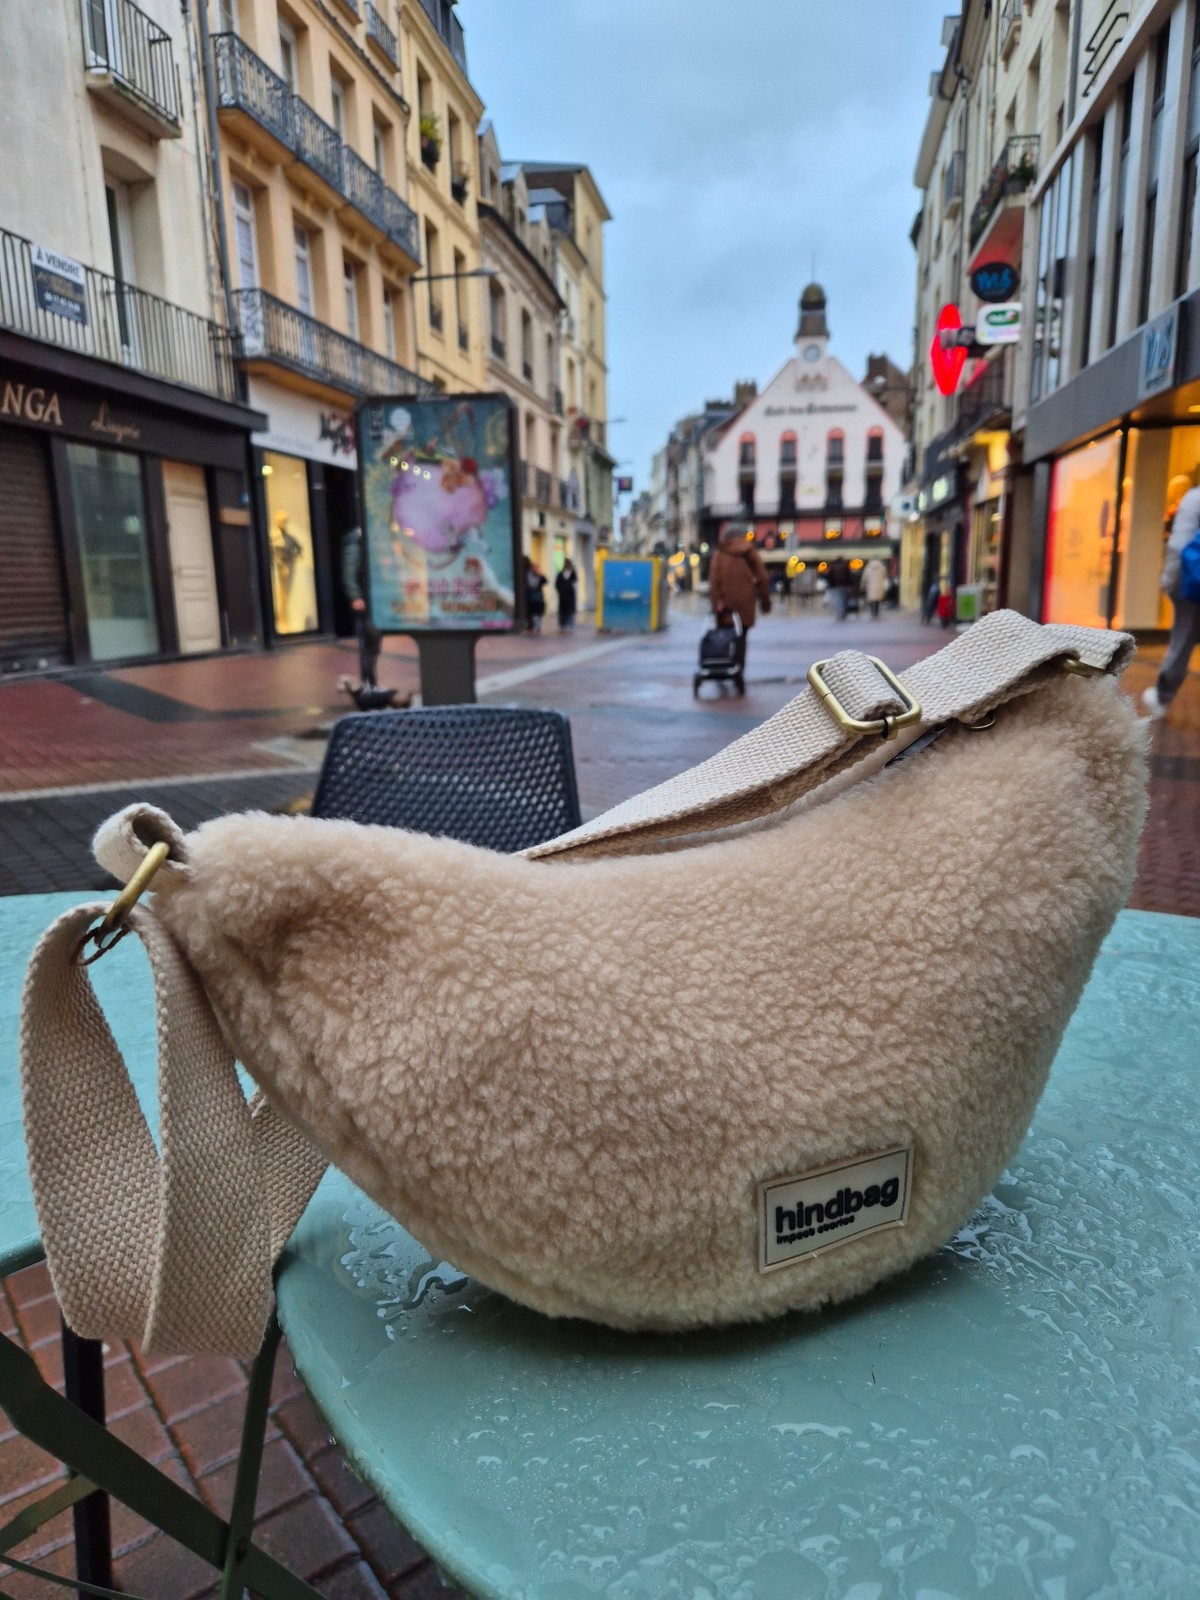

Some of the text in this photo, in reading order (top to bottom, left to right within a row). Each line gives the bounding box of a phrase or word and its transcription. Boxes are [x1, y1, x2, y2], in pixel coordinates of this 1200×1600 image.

[46, 251, 80, 277] VENDRE
[1, 381, 63, 426] NGA
[776, 1177, 899, 1233] hindbag
[777, 1215, 855, 1245] impact stories
